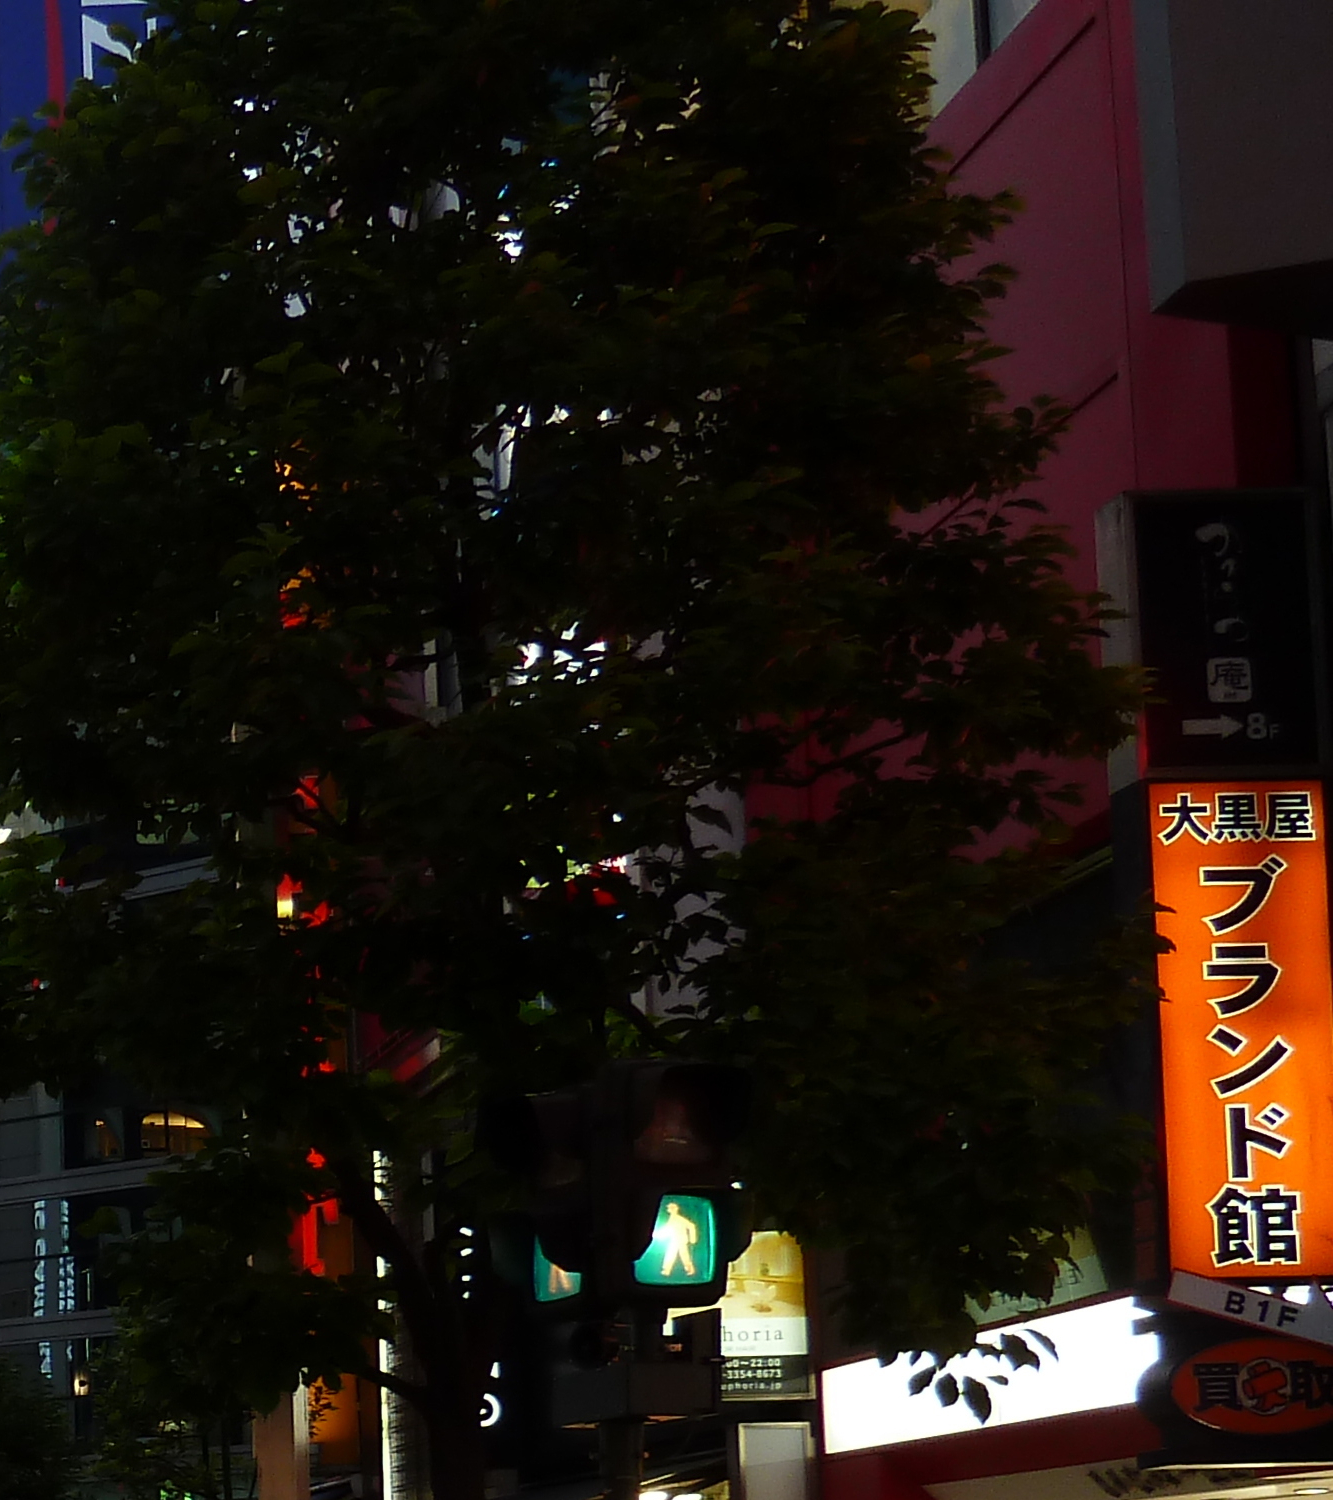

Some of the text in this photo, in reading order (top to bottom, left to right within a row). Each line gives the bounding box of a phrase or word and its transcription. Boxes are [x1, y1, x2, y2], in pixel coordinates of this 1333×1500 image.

[1245, 712, 1281, 741] 8F
[1159, 792, 1318, 843] 大黒屋
[1196, 855, 1303, 1267] ブランド館
[1223, 1290, 1300, 1328] B1F
[722, 1325, 785, 1342] horia
